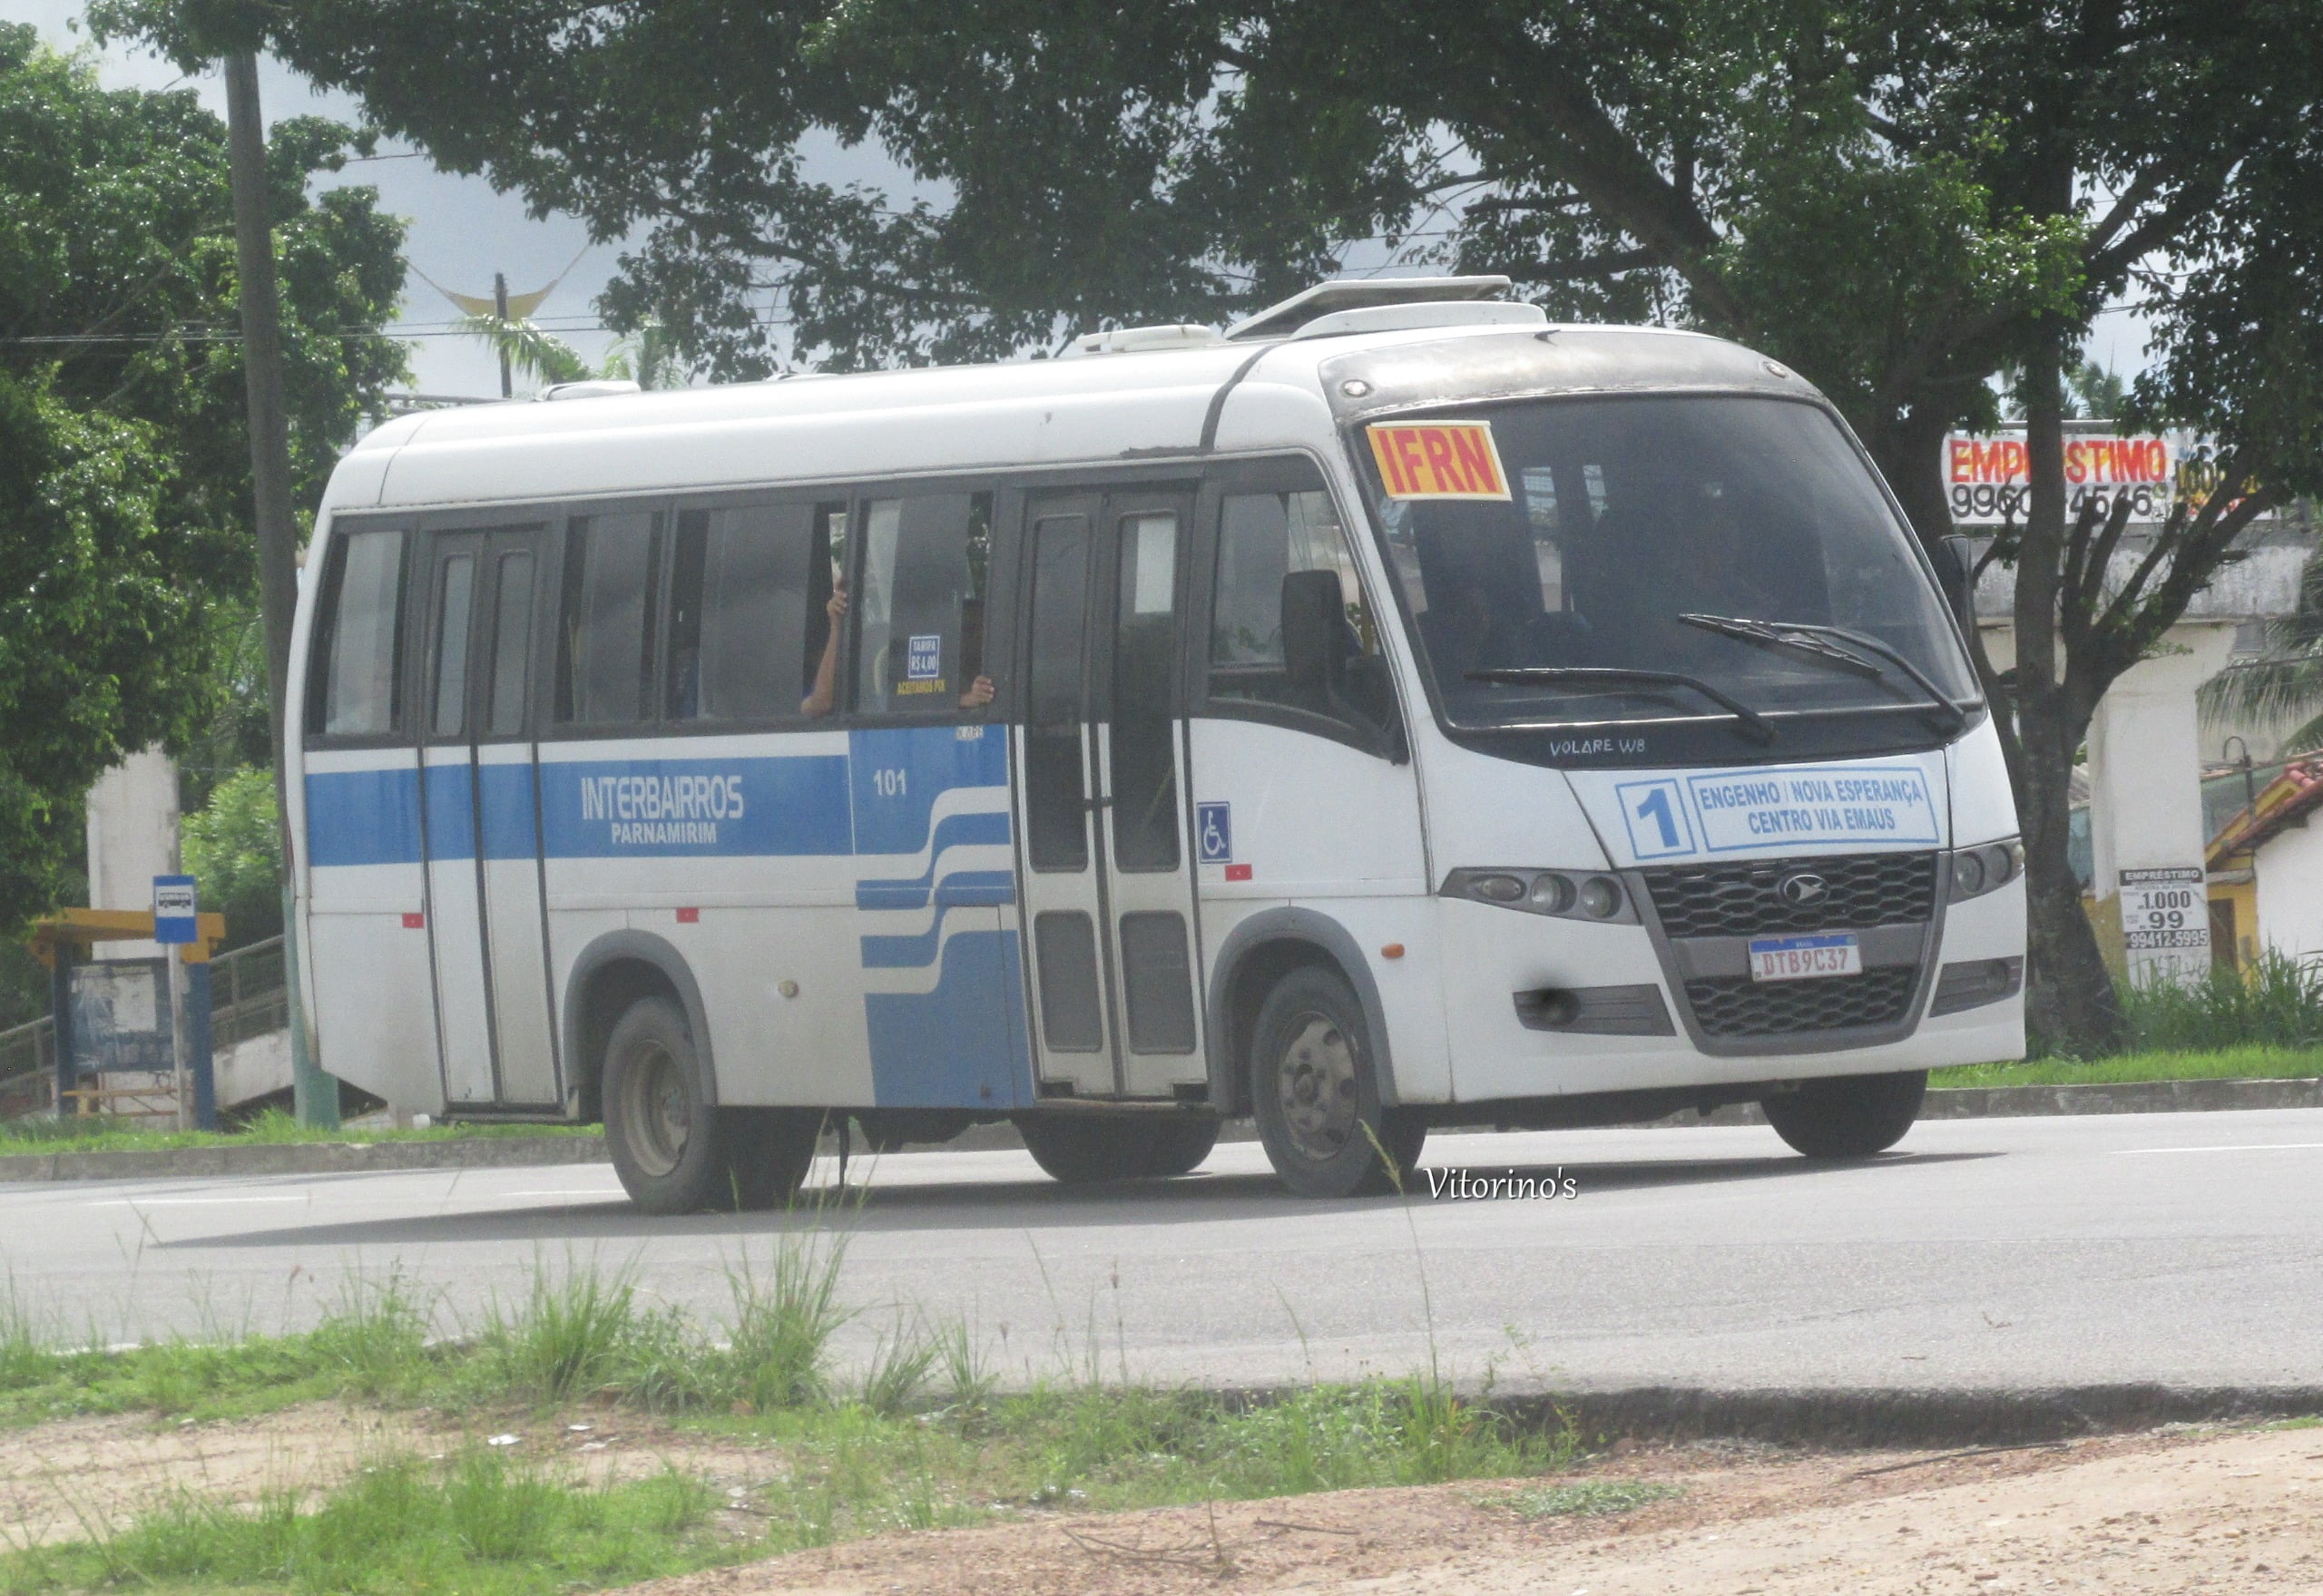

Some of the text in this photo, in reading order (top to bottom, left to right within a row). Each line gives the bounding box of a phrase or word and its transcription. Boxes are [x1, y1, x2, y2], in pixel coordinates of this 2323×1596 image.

[1377, 427, 1497, 493] IFRN
[1550, 739, 1646, 757] VOLARE W8
[874, 769, 906, 796] 101
[1699, 783, 1780, 810] ENGENHO
[1791, 780, 1835, 803] NOVA
[1836, 779, 1924, 807] ESPERANÇA
[581, 775, 744, 820] INTERBAIRROS
[1636, 788, 1680, 847] 1
[1748, 810, 1814, 834] CENTRO
[1814, 808, 1842, 831] VIA
[612, 822, 717, 845] PARNAMIRIM
[2142, 890, 2191, 909] 1.000
[2148, 910, 2184, 929] 99
[1761, 948, 1848, 975] DTB9C37
